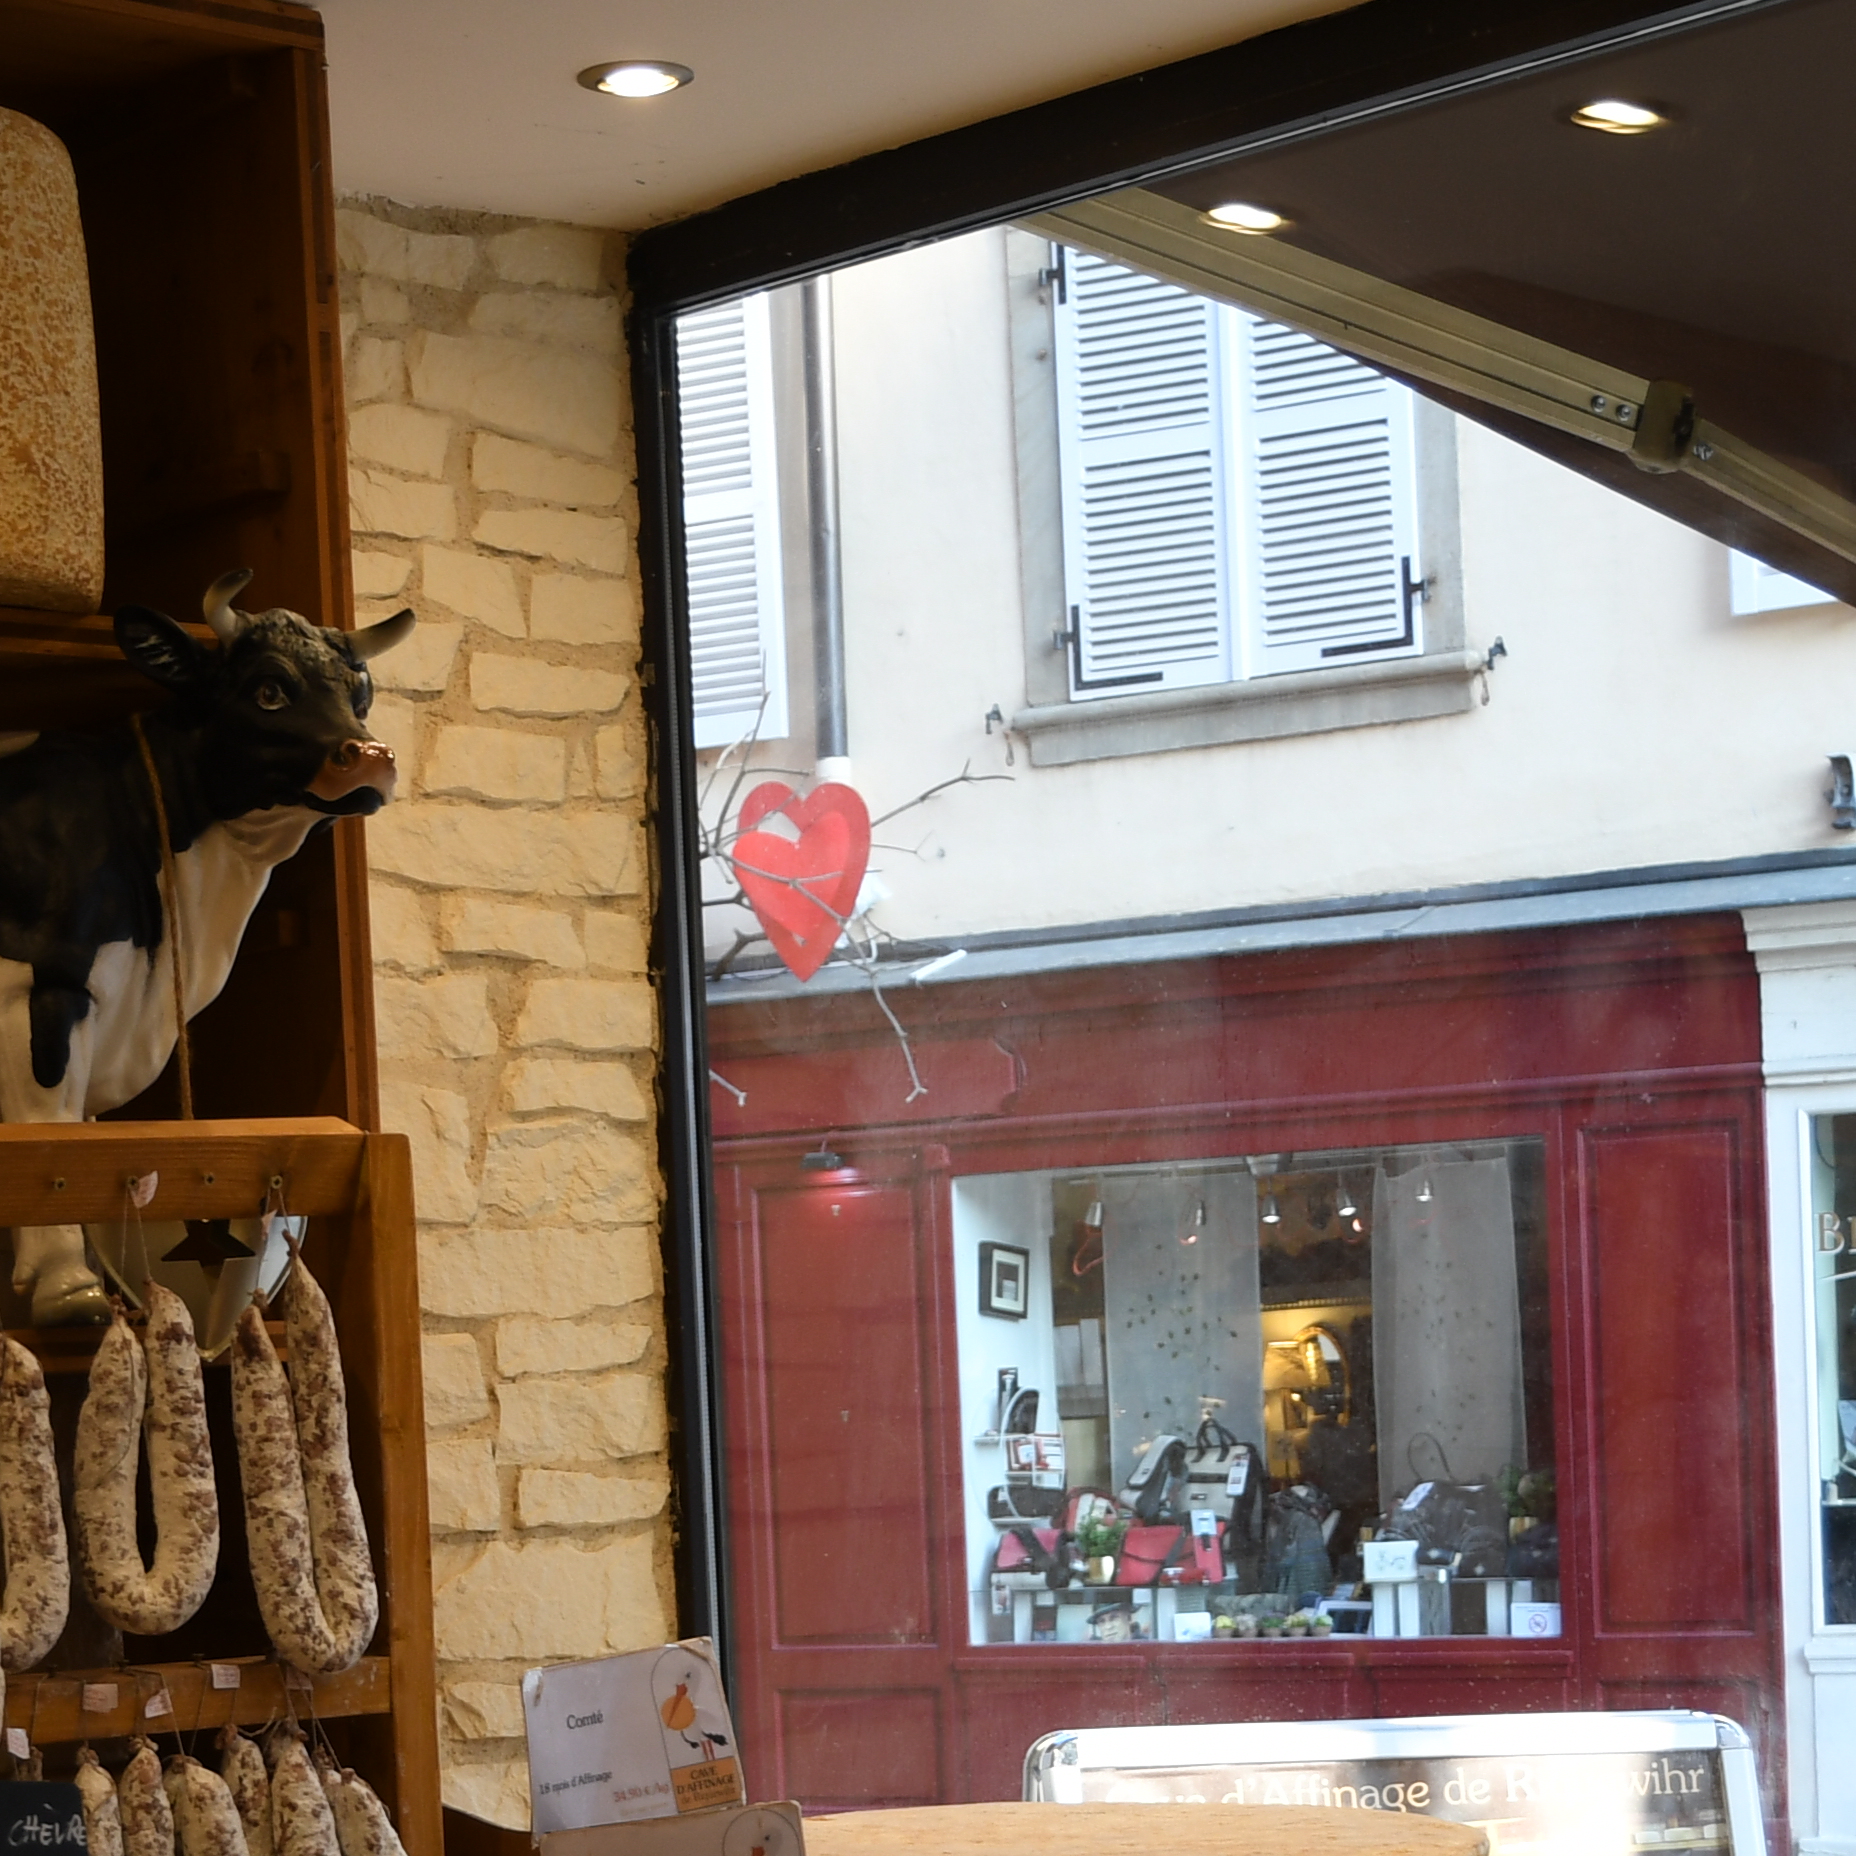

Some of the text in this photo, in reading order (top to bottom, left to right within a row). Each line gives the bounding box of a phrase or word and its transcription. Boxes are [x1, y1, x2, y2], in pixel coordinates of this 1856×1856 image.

[566, 1710, 603, 1730] Comté
[1222, 1766, 1432, 1813] d'Affinage
[1444, 1767, 1492, 1806] de
[1504, 1758, 1705, 1802] Rwihr
